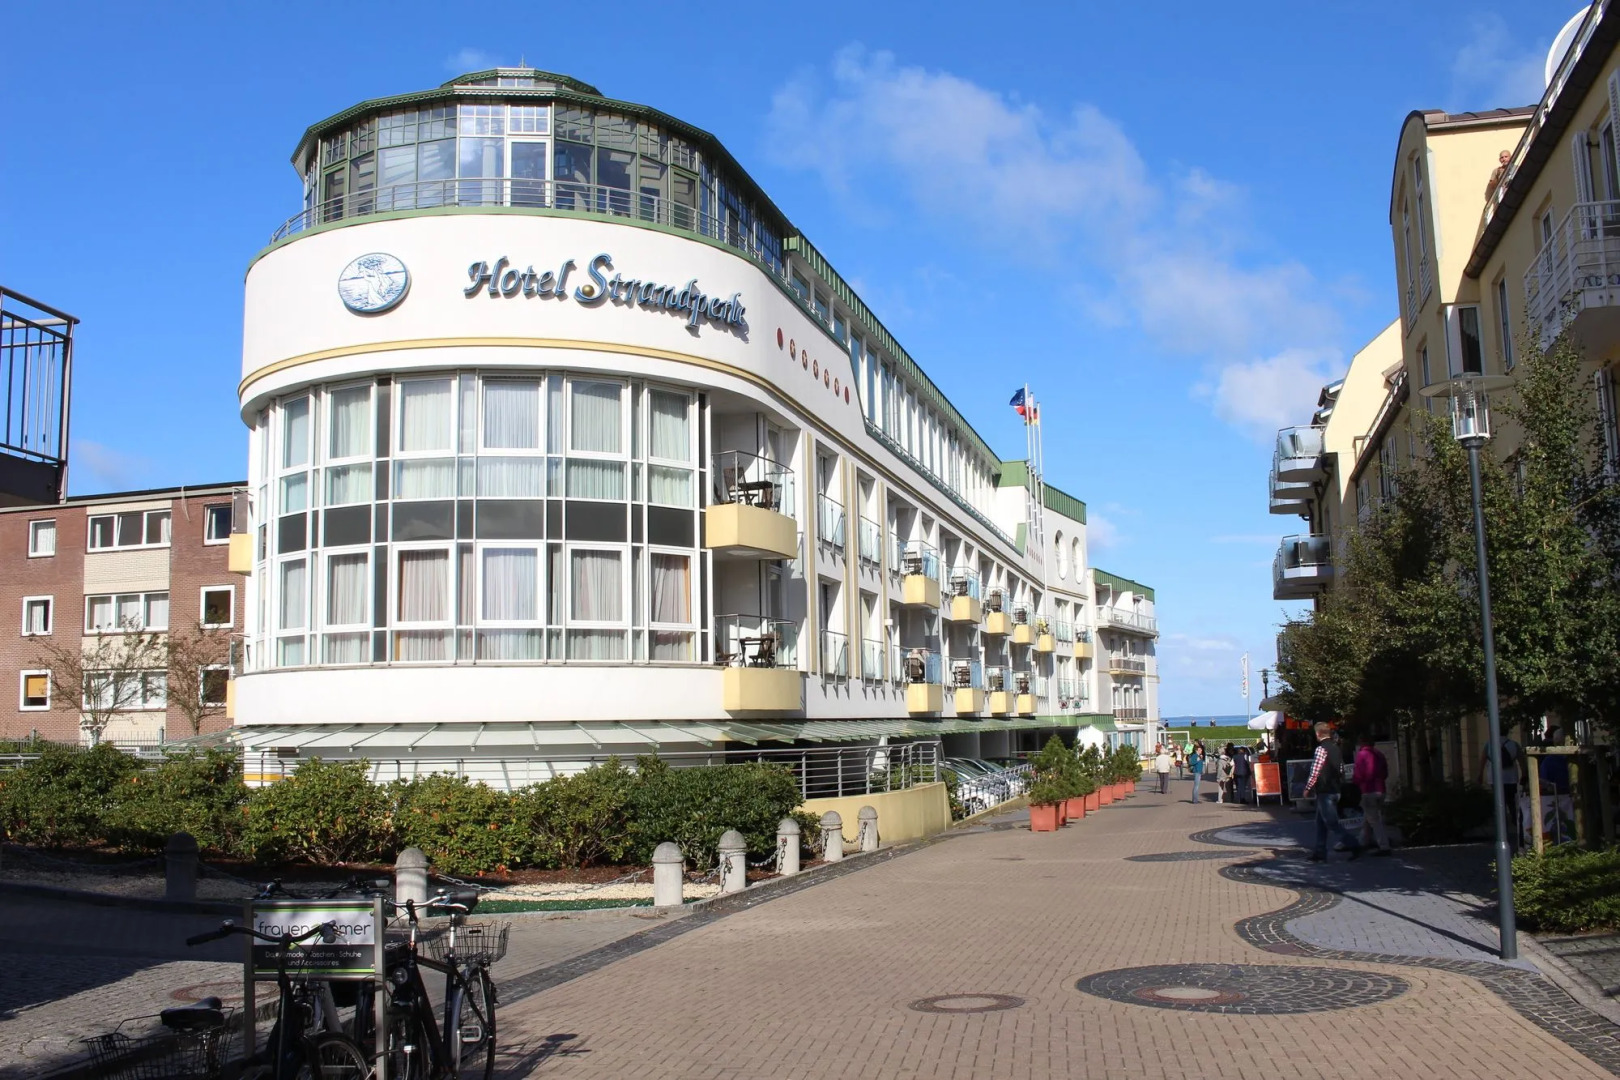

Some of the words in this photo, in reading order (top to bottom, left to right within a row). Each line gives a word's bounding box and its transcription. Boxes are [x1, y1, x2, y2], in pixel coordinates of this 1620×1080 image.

[463, 255, 576, 296] Hotel
[573, 252, 748, 328] Strandperle
[258, 921, 371, 936] frauenmer
